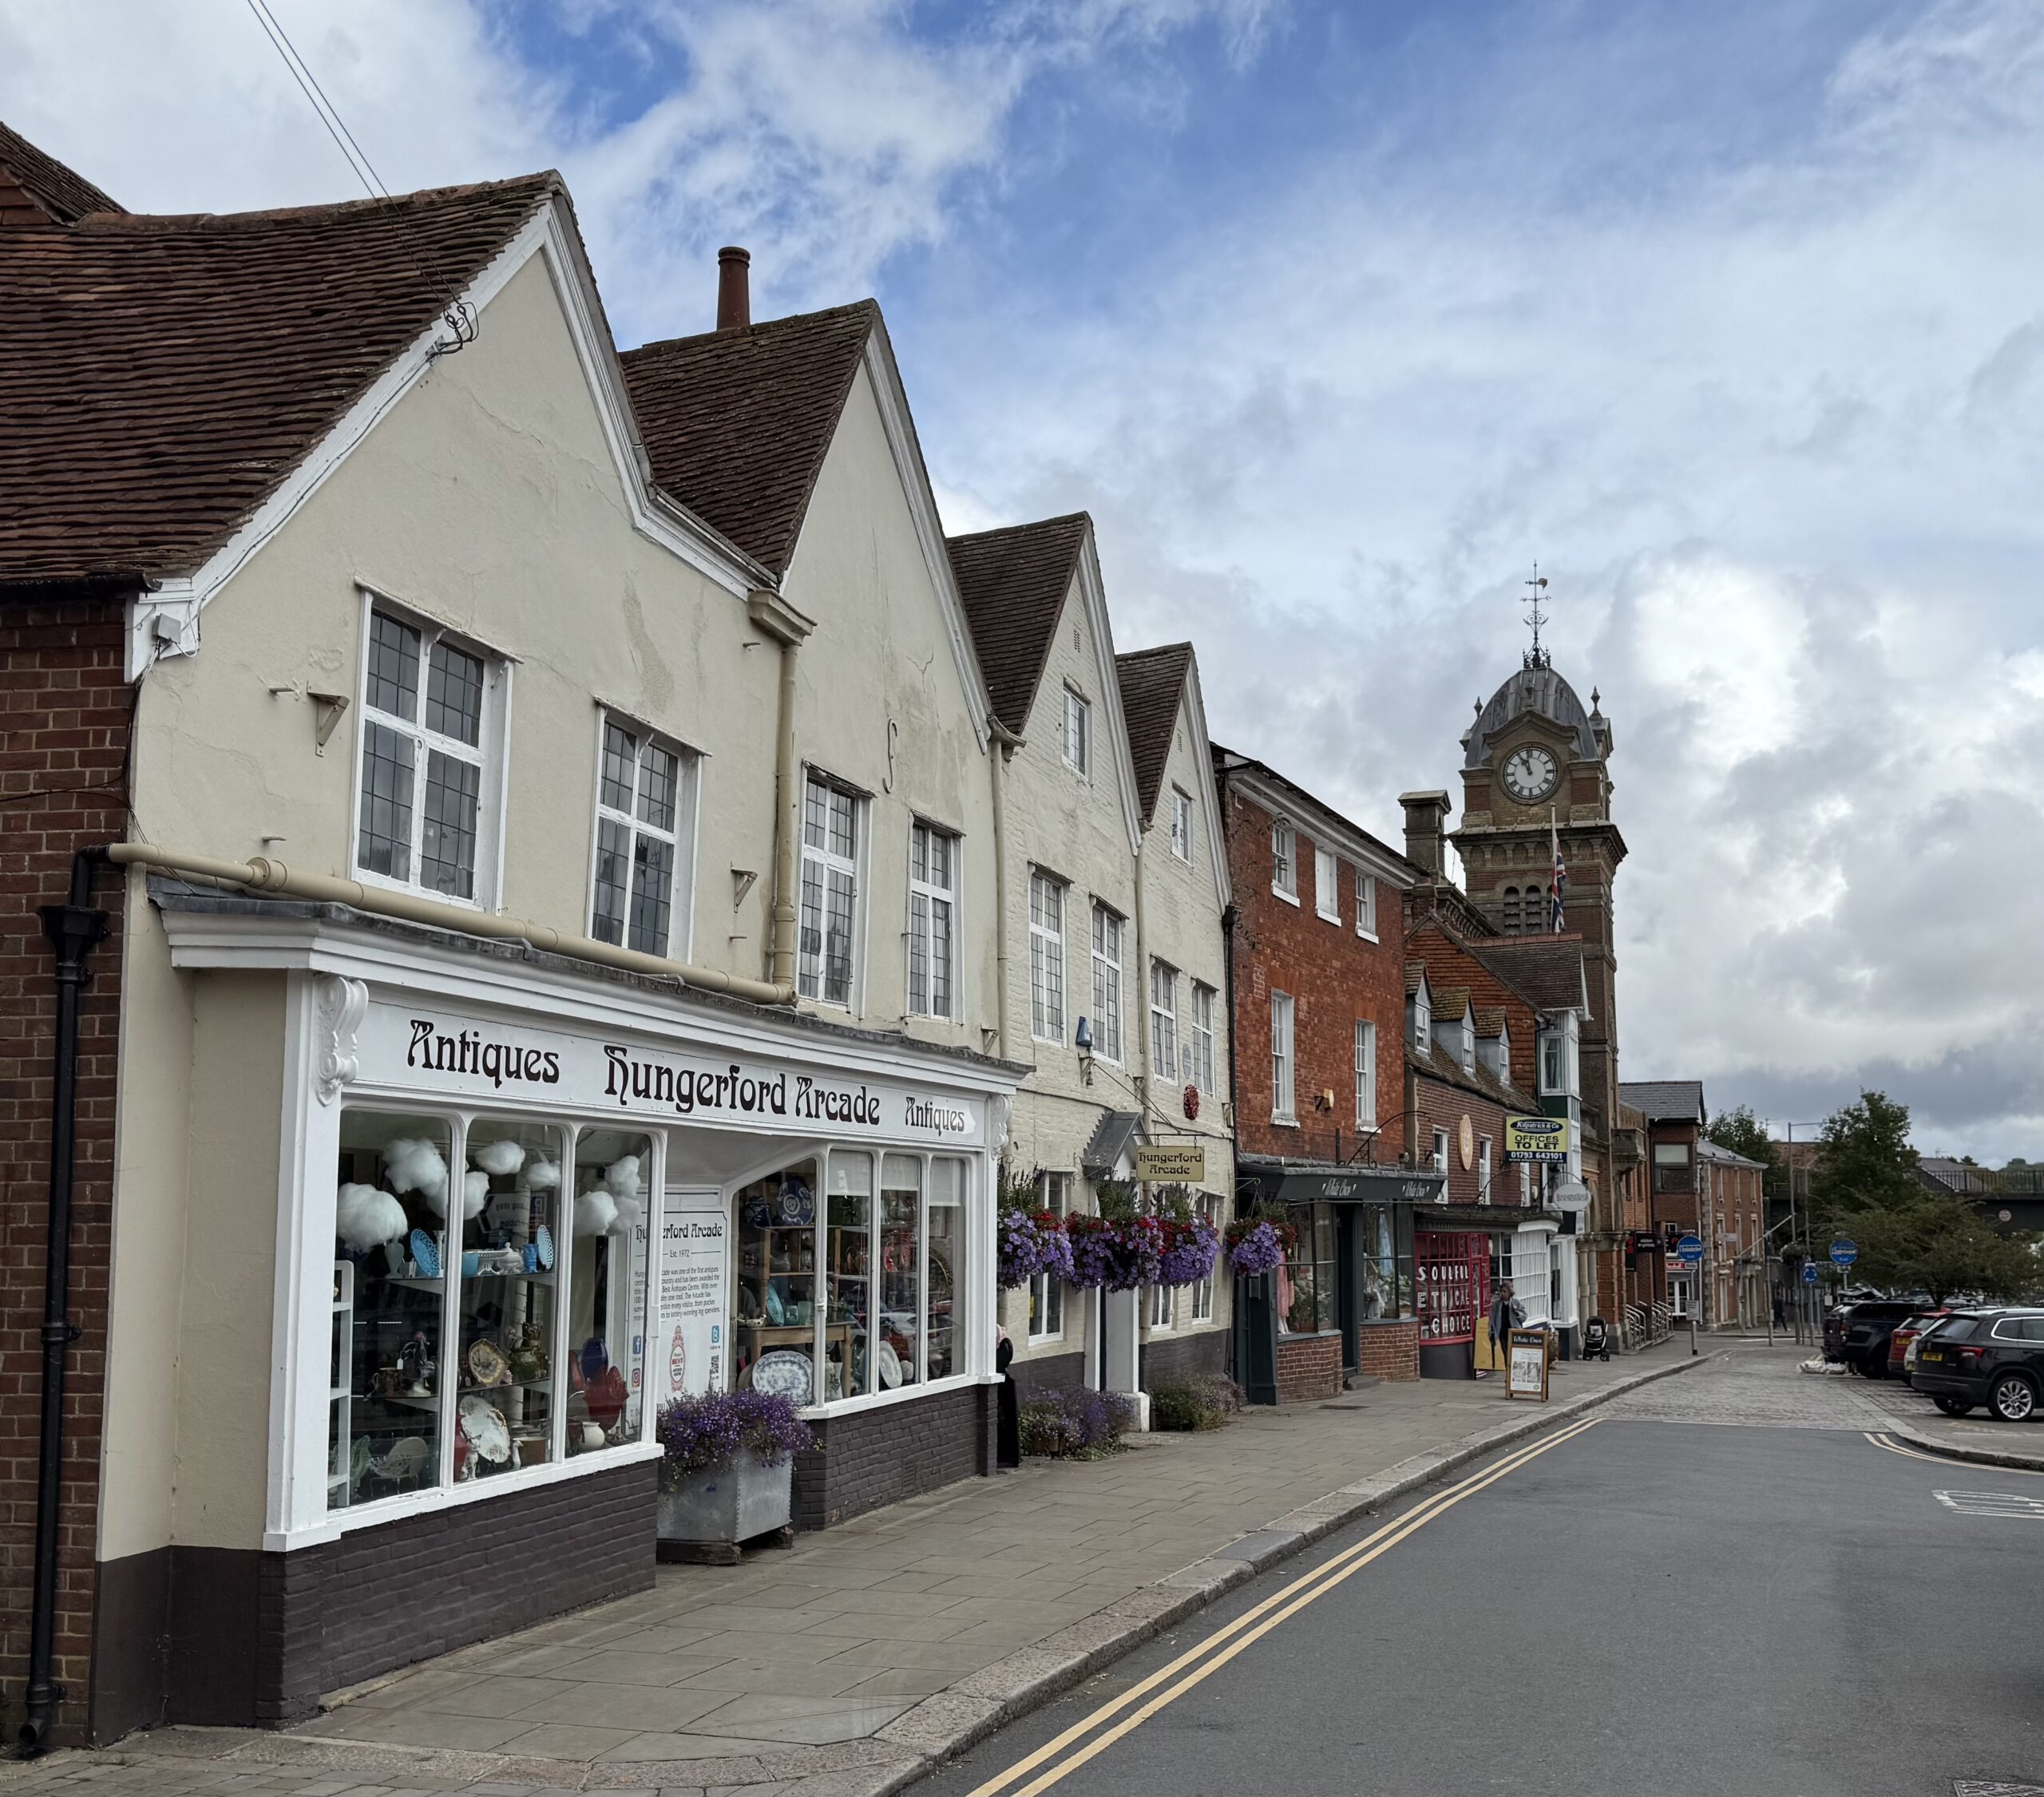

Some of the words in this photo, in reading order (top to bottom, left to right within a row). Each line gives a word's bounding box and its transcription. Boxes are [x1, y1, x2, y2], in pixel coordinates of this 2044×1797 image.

[408, 1019, 560, 1089] Antiques
[604, 1045, 787, 1113] Hungerford
[796, 1076, 881, 1126] Arcade
[905, 1096, 965, 1137] Antiques
[1517, 1121, 1545, 1130] Kilpatrick
[1139, 1152, 1202, 1163] Hungerford
[1150, 1165, 1190, 1174] Arcade
[691, 1223, 722, 1238] Arcade
[1416, 1265, 1468, 1281] SOULFUL
[1417, 1290, 1470, 1309] ETHICAL
[1432, 1316, 1470, 1333] CHOICE
